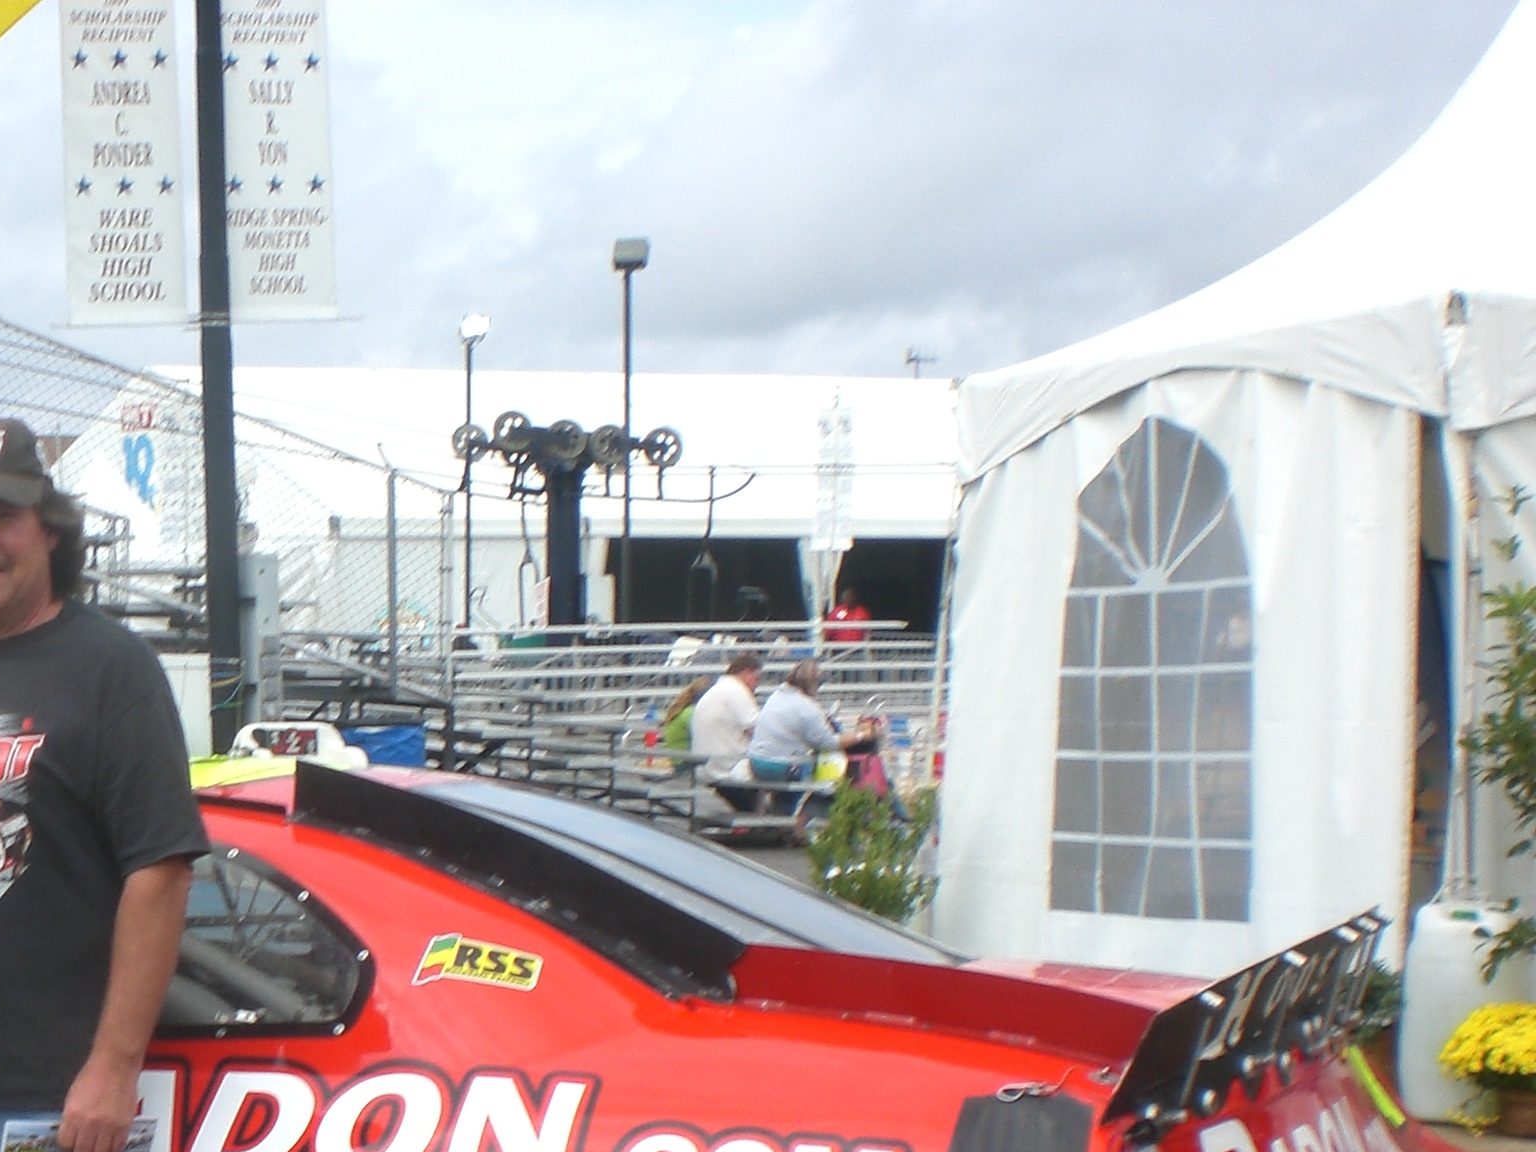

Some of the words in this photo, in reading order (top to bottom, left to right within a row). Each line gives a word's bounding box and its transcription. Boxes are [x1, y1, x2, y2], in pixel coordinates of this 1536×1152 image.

[91, 81, 151, 106] ANDREA
[248, 80, 295, 104] SALLY
[93, 143, 154, 168] PONDER
[99, 208, 154, 228] WARE
[88, 232, 164, 254] SHOALS
[242, 231, 310, 250] MONETTA
[101, 258, 152, 278] HIGH
[258, 253, 298, 273] HIGH
[88, 281, 166, 303] SCHOOL
[249, 276, 307, 295] SCHOOL
[452, 944, 535, 980] RSS
